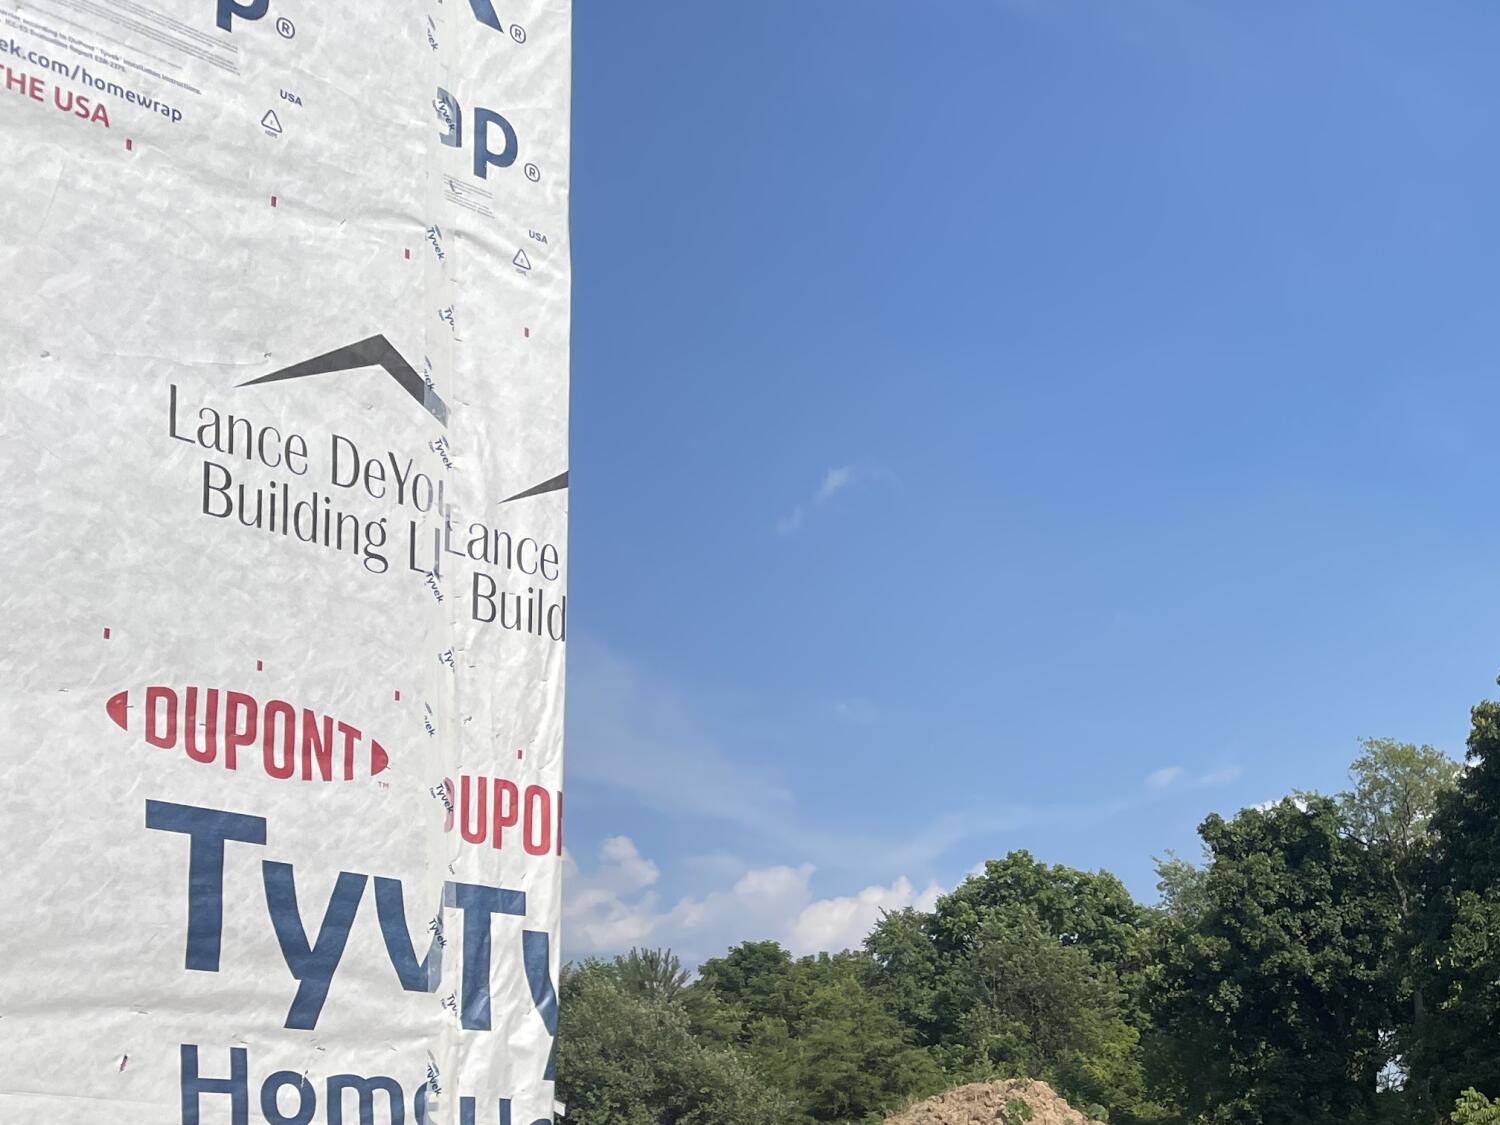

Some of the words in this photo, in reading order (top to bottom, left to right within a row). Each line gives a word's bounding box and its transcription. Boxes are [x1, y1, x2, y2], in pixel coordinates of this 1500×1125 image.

[0, 64, 45, 103] HE
[54, 86, 110, 128] USA
[279, 89, 303, 107] USA
[427, 226, 445, 260] Tyvek
[528, 229, 549, 245] USA
[168, 383, 309, 476] Lance
[434, 437, 453, 471] Tyvek
[202, 460, 390, 575] Building
[444, 504, 560, 582] Lance
[425, 571, 444, 605] Tyvek
[144, 686, 362, 782] DUPONT
[436, 783, 454, 814] Tyvek
[443, 775, 563, 857] UPO
[428, 918, 448, 948] Tyvek
